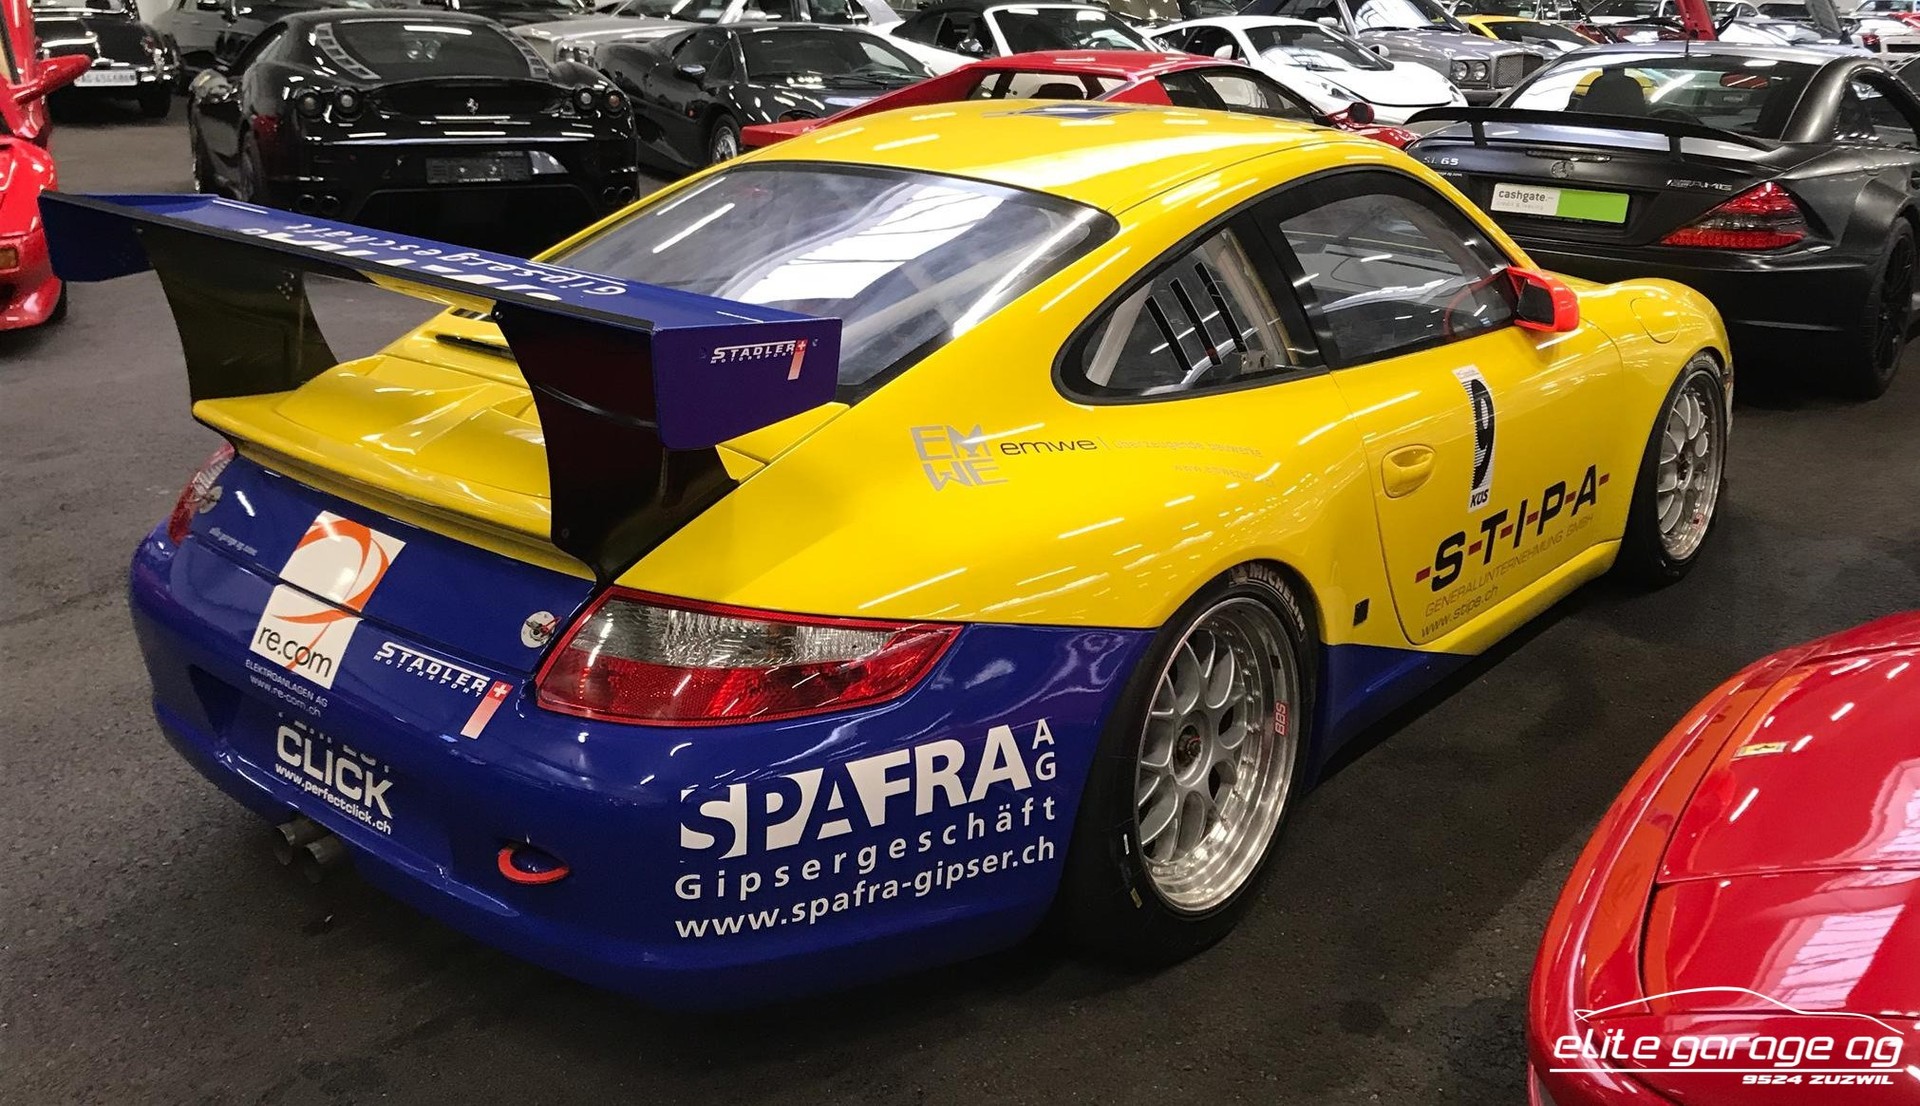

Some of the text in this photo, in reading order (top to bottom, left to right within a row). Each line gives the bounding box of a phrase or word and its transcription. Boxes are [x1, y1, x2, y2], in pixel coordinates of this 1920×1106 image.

[1440, 157, 1459, 166] 65
[284, 222, 627, 298] Gipsergeschäft
[711, 340, 797, 361] STADLER
[1000, 438, 1098, 456] emwe
[1248, 562, 1306, 632] MICHELIN
[258, 626, 333, 678] re.com
[372, 655, 482, 697] MOTORSPORT
[376, 641, 491, 692] STADLER
[315, 695, 329, 708] AG
[1274, 701, 1287, 736] BBS
[276, 725, 394, 820] CLICK
[680, 724, 1032, 861] SPAFRA
[275, 763, 391, 835] www.perfectclick.ch
[674, 796, 1055, 901] Gipsergeschäft
[675, 835, 1055, 938] www.spafra-gipser.ch
